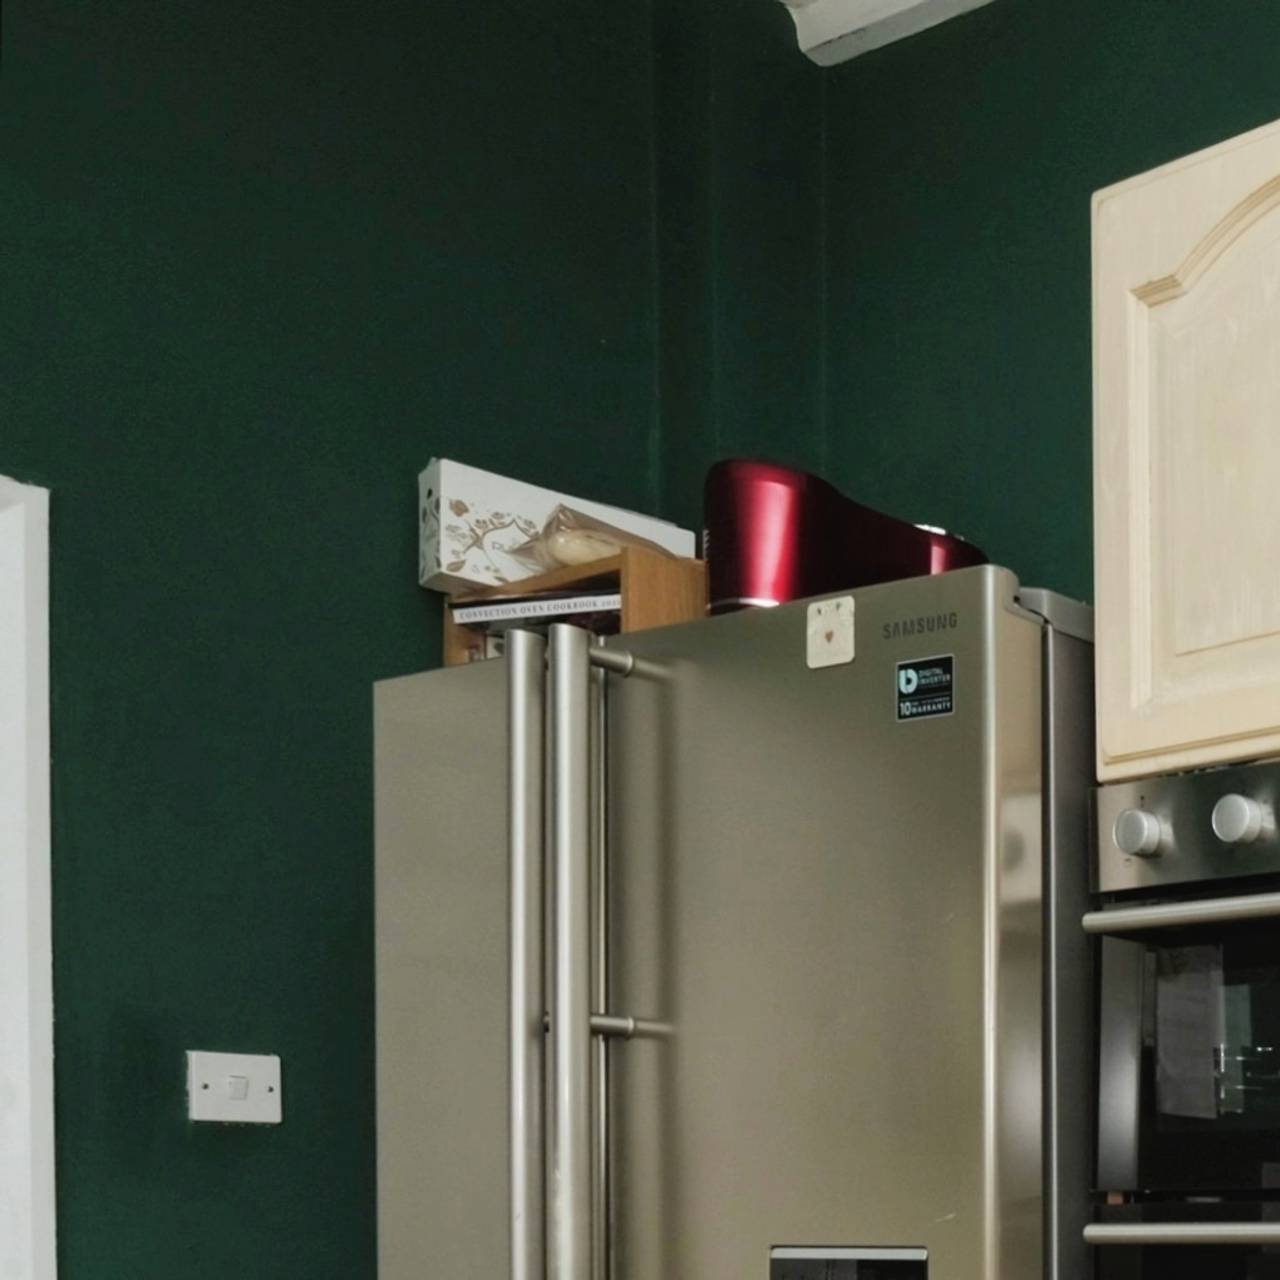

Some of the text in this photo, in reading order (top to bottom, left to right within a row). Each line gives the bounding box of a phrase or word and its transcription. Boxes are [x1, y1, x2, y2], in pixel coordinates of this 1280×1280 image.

[519, 604, 545, 615] OVEN
[882, 612, 958, 640] SAMSUNG
[899, 701, 911, 717] 10
[911, 701, 952, 715] WARRANTY
